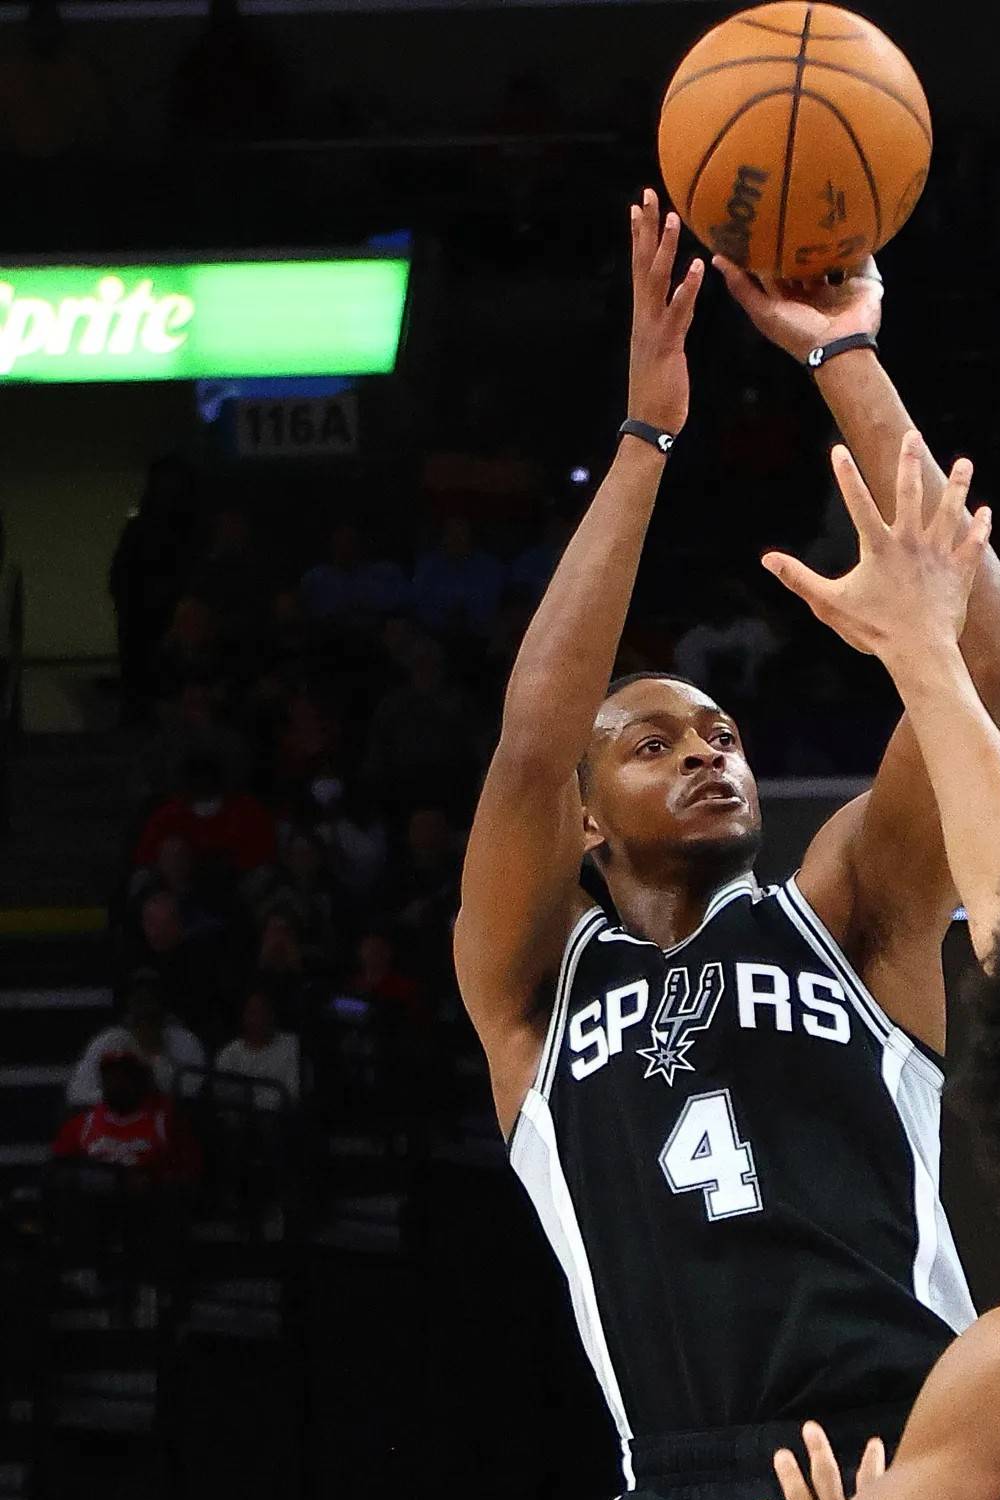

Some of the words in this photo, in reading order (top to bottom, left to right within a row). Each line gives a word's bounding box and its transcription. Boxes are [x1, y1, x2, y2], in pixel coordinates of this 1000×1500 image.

[0, 274, 195, 376] prite
[568, 960, 852, 1086] SPURS
[657, 1088, 764, 1222] 4
